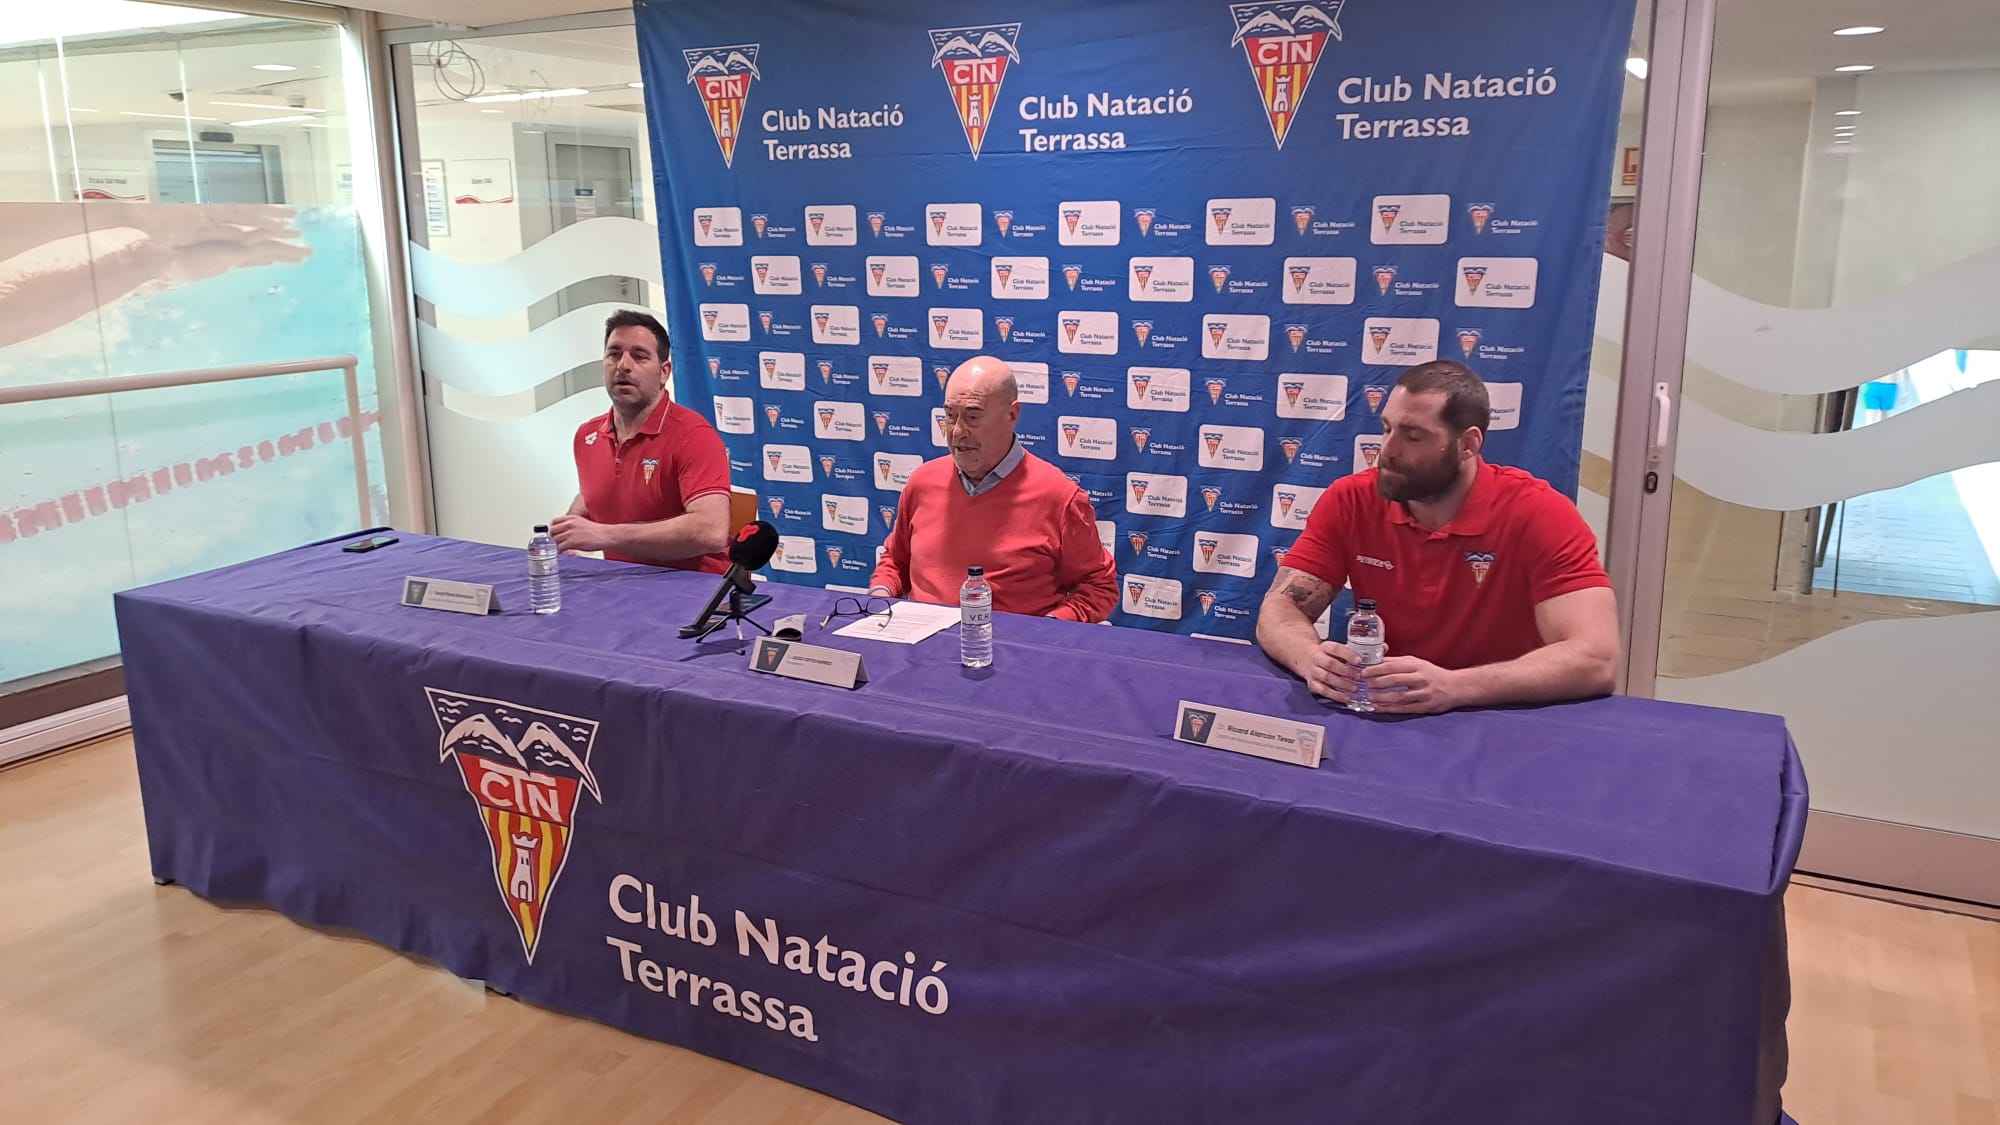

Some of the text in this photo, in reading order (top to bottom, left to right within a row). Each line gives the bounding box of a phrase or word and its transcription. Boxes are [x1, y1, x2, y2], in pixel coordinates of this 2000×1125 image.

[1258, 34, 1312, 65] CTN
[954, 58, 996, 84] CTN
[1337, 66, 1557, 104] Club Natació
[705, 74, 742, 99] CTN
[761, 103, 904, 132] Club Natació
[1019, 87, 1193, 121] Club Natació
[1018, 128, 1127, 152] Terrassa
[1335, 113, 1471, 140] Terrassa
[762, 139, 853, 161] Terrassa
[480, 758, 562, 823] CTN
[607, 874, 949, 1015] Club Natació
[606, 935, 818, 1042] Terrassa
